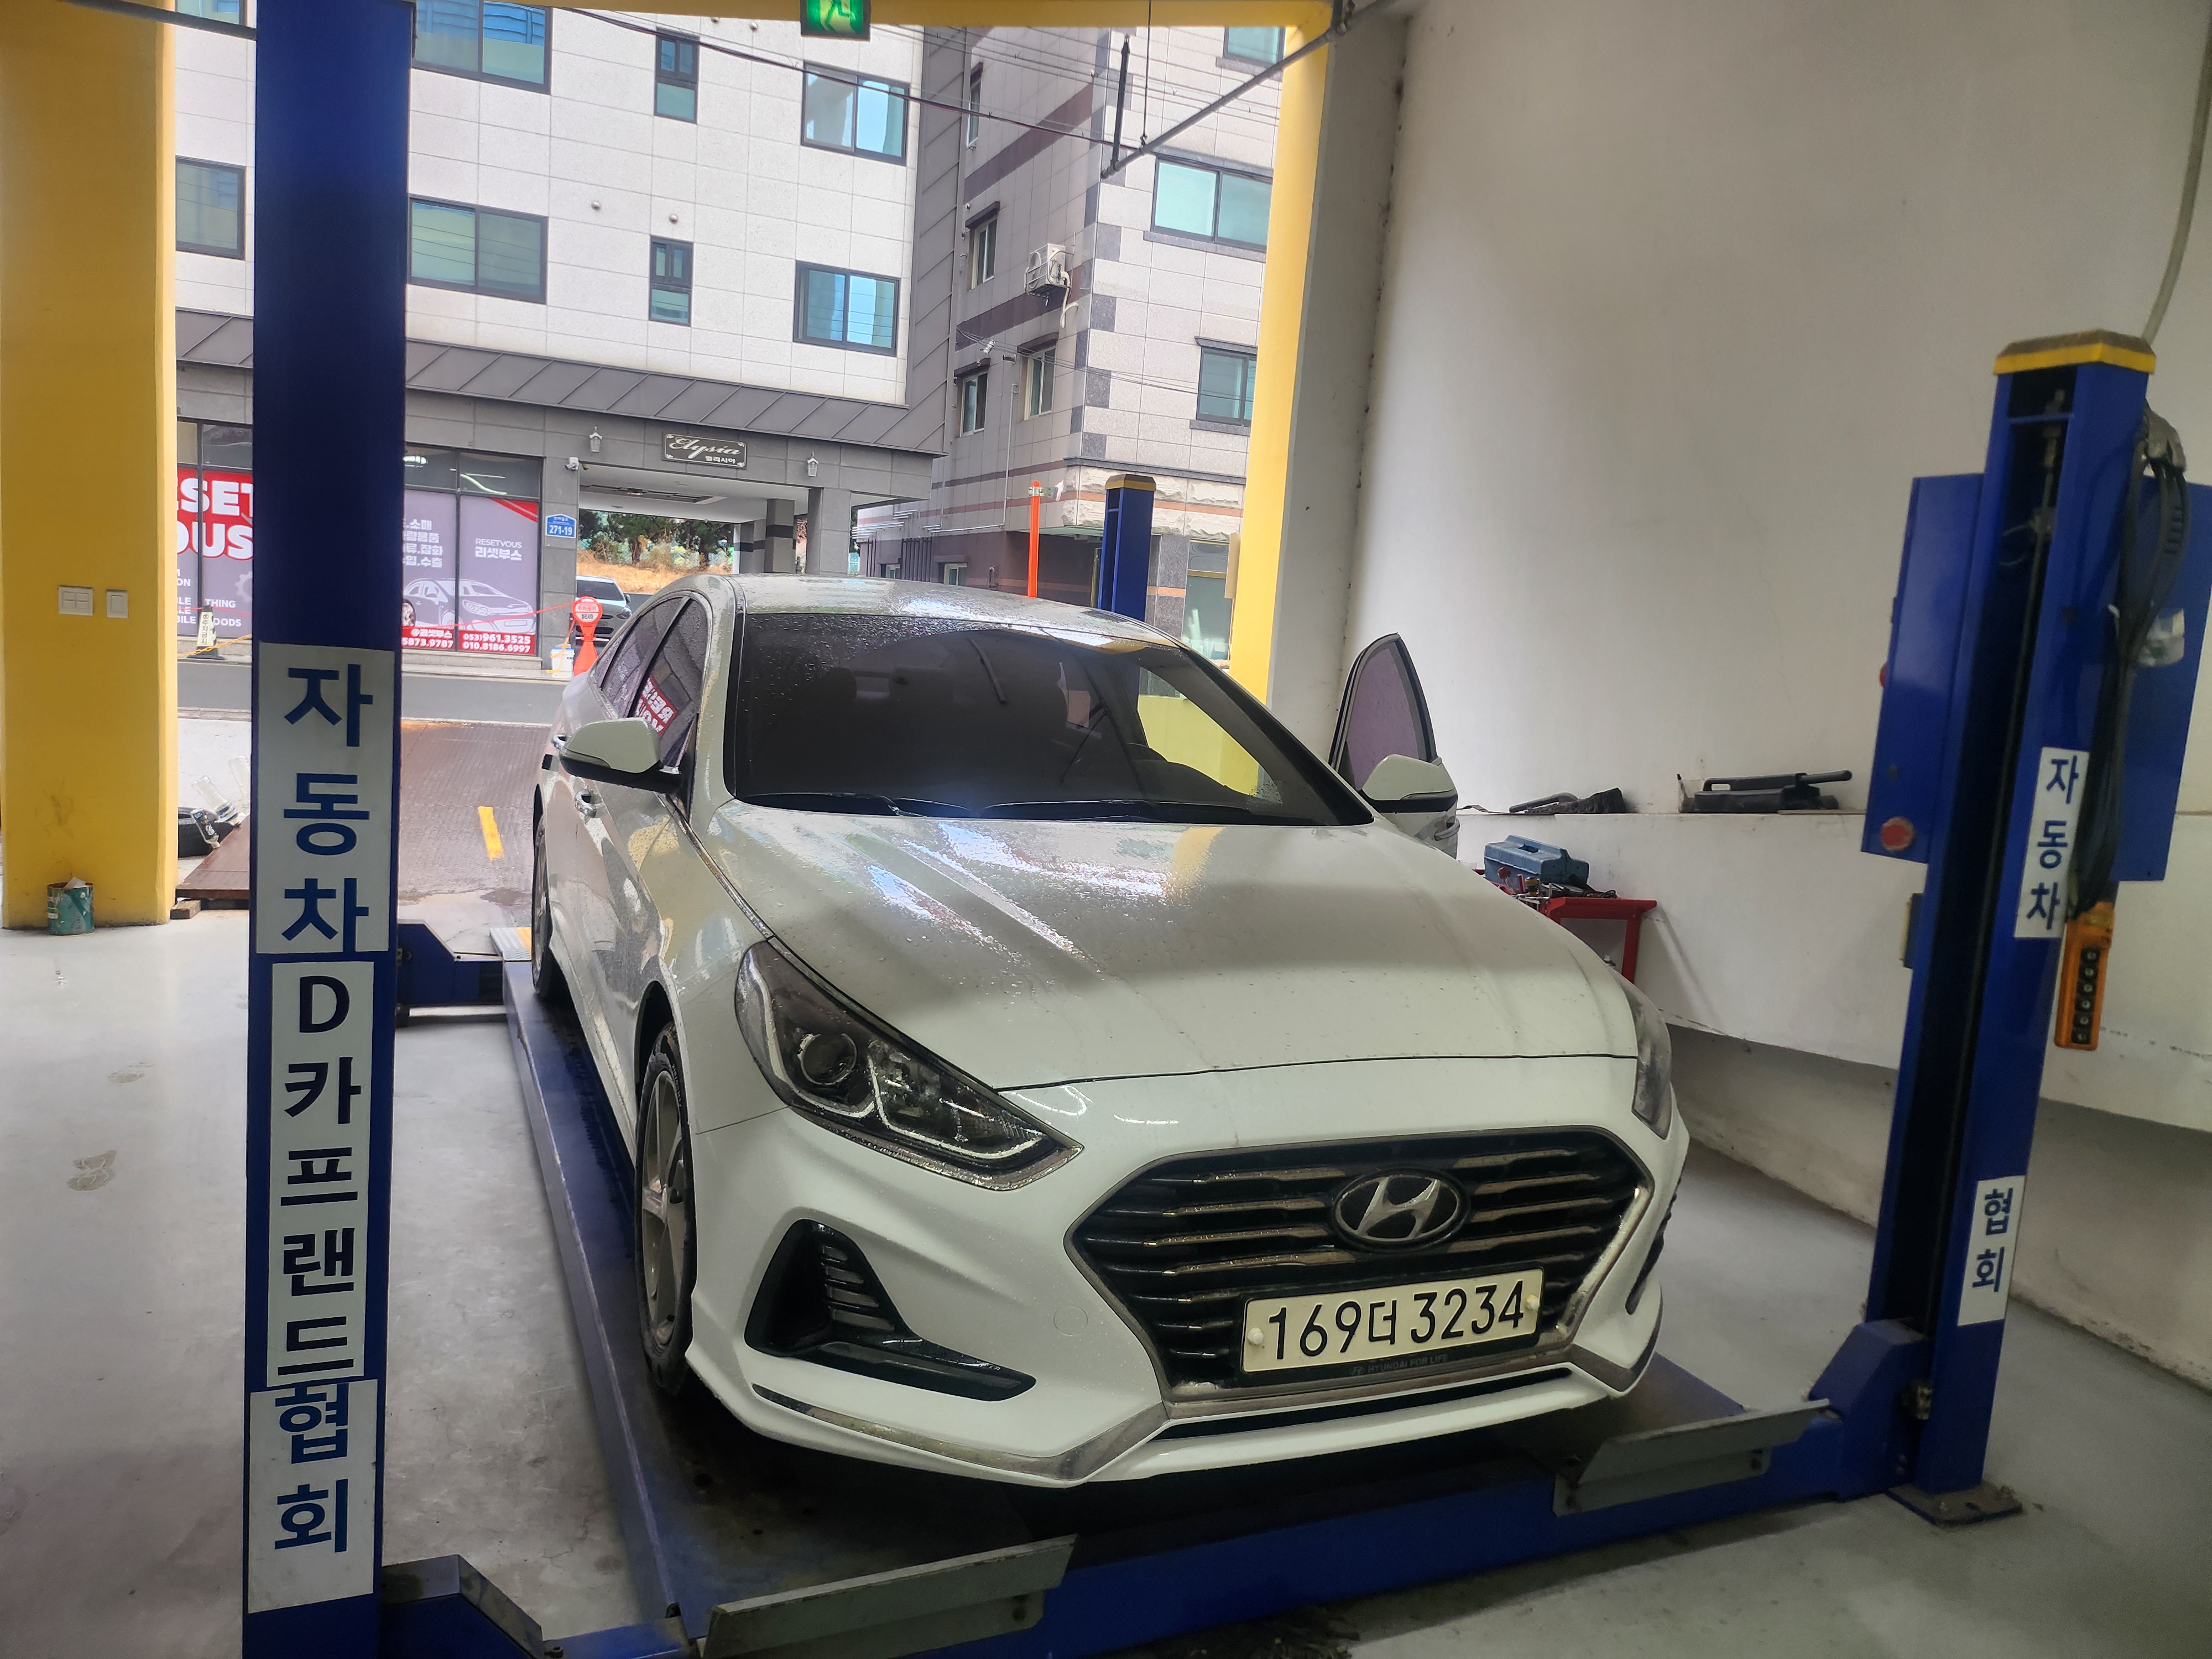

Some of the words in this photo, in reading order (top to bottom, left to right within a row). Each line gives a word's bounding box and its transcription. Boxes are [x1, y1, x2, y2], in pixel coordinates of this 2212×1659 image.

[403, 518, 432, 530] .소매
[549, 525, 572, 536] 271-19
[403, 530, 440, 544] 량용품
[476, 538, 523, 549] RESETVOUS
[403, 542, 444, 556] 류.잡화
[475, 546, 523, 561] 리셋부스
[403, 555, 443, 568] 입.수출
[205, 598, 236, 608] THING
[213, 617, 242, 627] OODS
[463, 633, 531, 644] 053)961.3525
[462, 641, 531, 653] 010.8186.6997
[281, 664, 373, 952] 자동차
[2027, 755, 2079, 930] 자동차
[278, 975, 361, 1376] D카프랜드
[1972, 1187, 2013, 1292] 협회
[1268, 1280, 1525, 1360] 169더3234
[1368, 1360, 1408, 1374] HYUNDAI
[1410, 1357, 1428, 1368] FOR
[1430, 1353, 1449, 1364] LIFE
[274, 1383, 349, 1553] 협회
